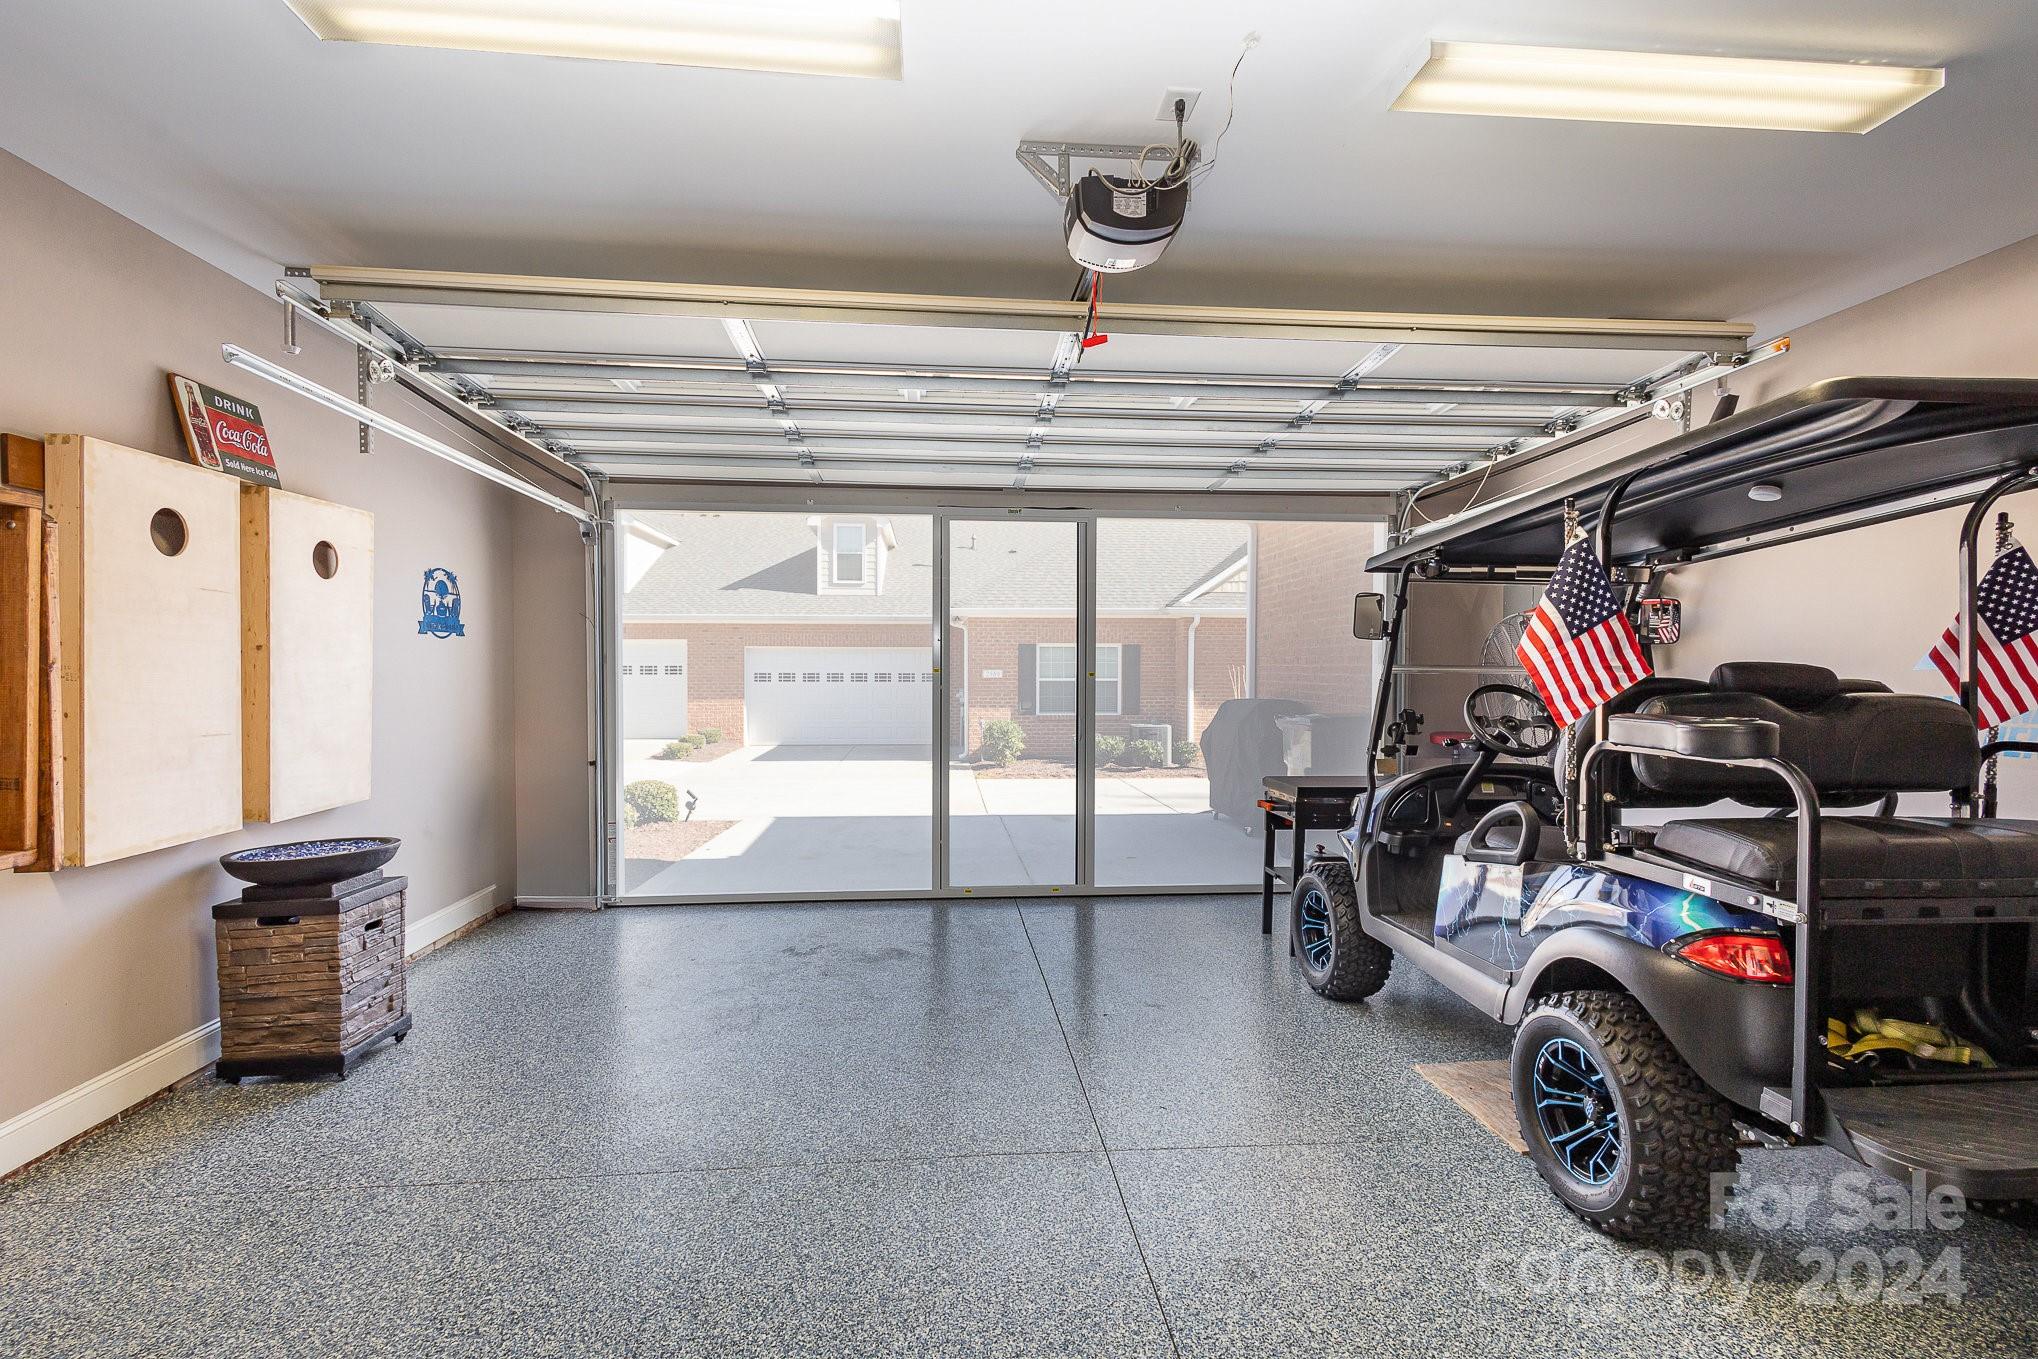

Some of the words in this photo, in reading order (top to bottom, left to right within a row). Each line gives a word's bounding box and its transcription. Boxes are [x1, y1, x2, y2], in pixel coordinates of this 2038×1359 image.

[214, 396, 255, 420] DRINK
[225, 458, 240, 470] Sold
[240, 462, 256, 474] Here
[255, 467, 265, 477] Ice
[264, 469, 278, 481] Cold
